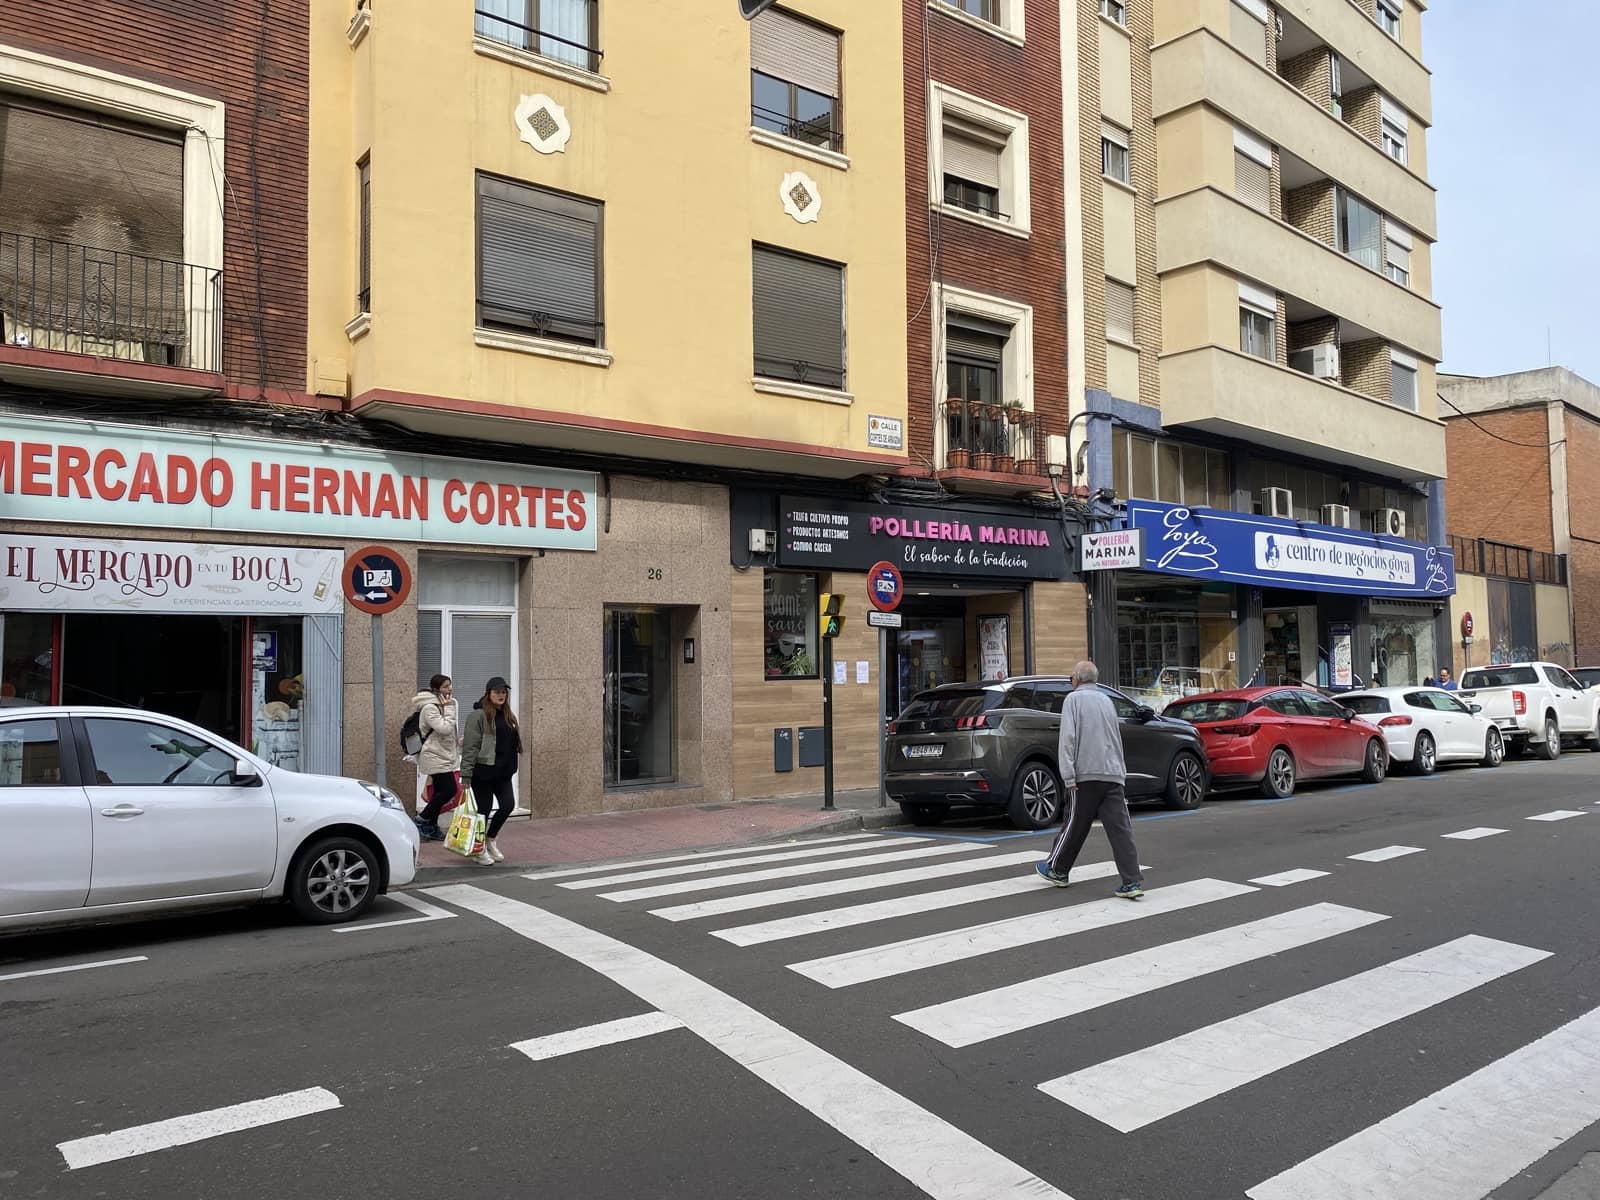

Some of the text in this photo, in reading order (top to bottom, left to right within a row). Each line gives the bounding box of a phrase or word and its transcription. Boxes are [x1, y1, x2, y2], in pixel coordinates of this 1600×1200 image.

[881, 422, 897, 431] CALLE
[251, 462, 428, 520] HERNAN
[443, 479, 587, 531] CORTES
[793, 511, 849, 525] TRUFA CULTIVO PROPIO
[793, 527, 848, 539] PRODUCTOS ARTESANOS
[869, 516, 1051, 547] POLLERÍA MARINA
[793, 541, 831, 552] COMIDA CASERA
[1098, 533, 1130, 547] POLLERÍA
[1158, 508, 1218, 571] Goya
[904, 545, 1029, 568] El sabor de la tradición
[1085, 545, 1137, 560] MARINA
[1286, 543, 1411, 580] centro de negocios goya
[6, 546, 303, 597] EL MERCADO EN TU BOCA
[647, 568, 662, 581] 26
[1424, 546, 1450, 593] Goya
[366, 571, 375, 586] P
